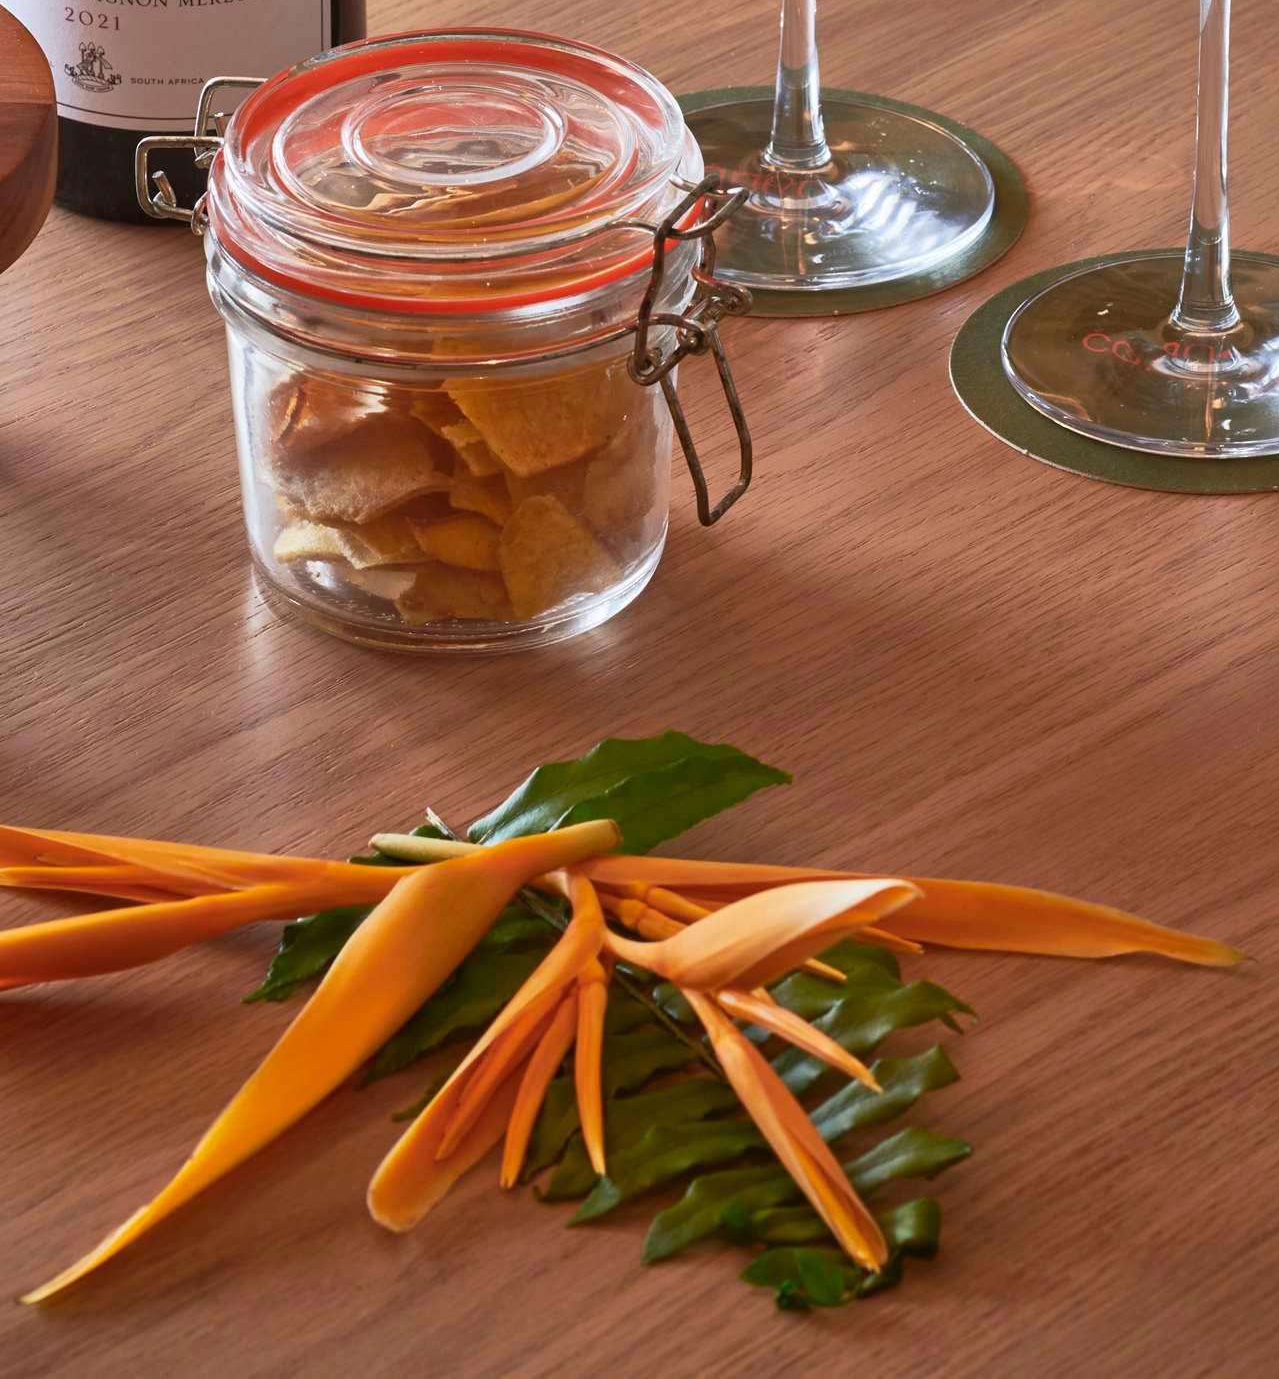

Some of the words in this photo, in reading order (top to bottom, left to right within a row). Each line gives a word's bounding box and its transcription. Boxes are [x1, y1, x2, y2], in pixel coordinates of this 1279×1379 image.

[64, 6, 121, 31] 2021
[130, 77, 165, 86] SOUTH
[167, 77, 205, 86] AFRICA
